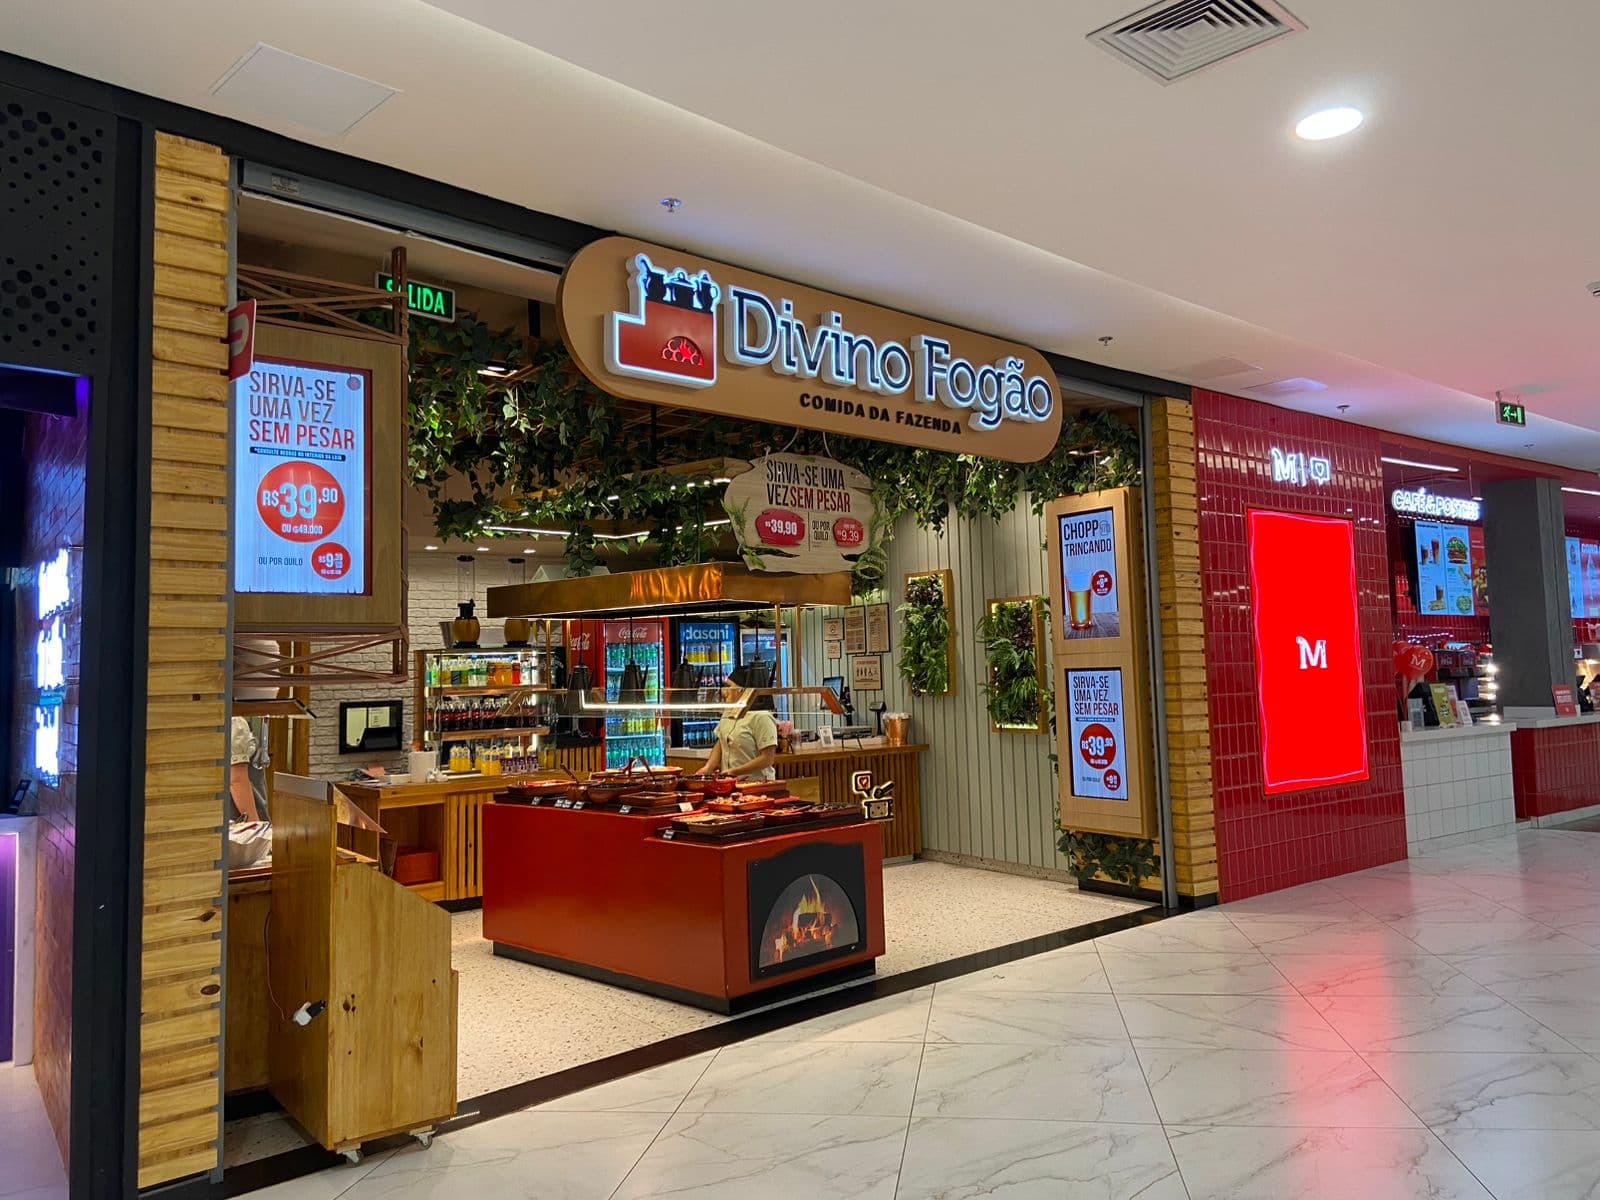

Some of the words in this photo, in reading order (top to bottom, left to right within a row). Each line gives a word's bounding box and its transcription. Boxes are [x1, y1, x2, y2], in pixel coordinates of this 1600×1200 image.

[386, 279, 445, 315] LIDA
[726, 286, 912, 394] Divino
[914, 335, 1053, 431] Fogão
[250, 370, 336, 402] SIRVA-SE
[250, 395, 292, 420] UMA
[298, 400, 333, 424] VEZ
[800, 393, 865, 418] COMIDA
[869, 406, 890, 423] DA
[896, 410, 962, 435] FAZENDA
[249, 419, 290, 444] SEM
[296, 424, 354, 450] PESAR
[766, 459, 818, 488] SIRVA-SE
[821, 467, 845, 490] UMA
[767, 483, 789, 507] VEZ
[790, 486, 813, 509] SEM
[817, 489, 850, 512] PESAR
[1392, 486, 1425, 512] CAFÉ
[814, 530, 829, 541] QUILO
[820, 521, 830, 531] POR
[1063, 519, 1099, 541] CHOPP
[1064, 538, 1112, 558] TRINCANDO
[269, 557, 283, 566] POR
[283, 557, 304, 567] QUILO
[685, 625, 729, 640] dasani
[1296, 635, 1328, 670] M
[1073, 675, 1109, 689] SIRVA-SE
[1074, 689, 1091, 702] UMA
[1093, 689, 1109, 702] VEZ
[1075, 702, 1091, 715] SEM
[1093, 702, 1119, 716] PESAR
